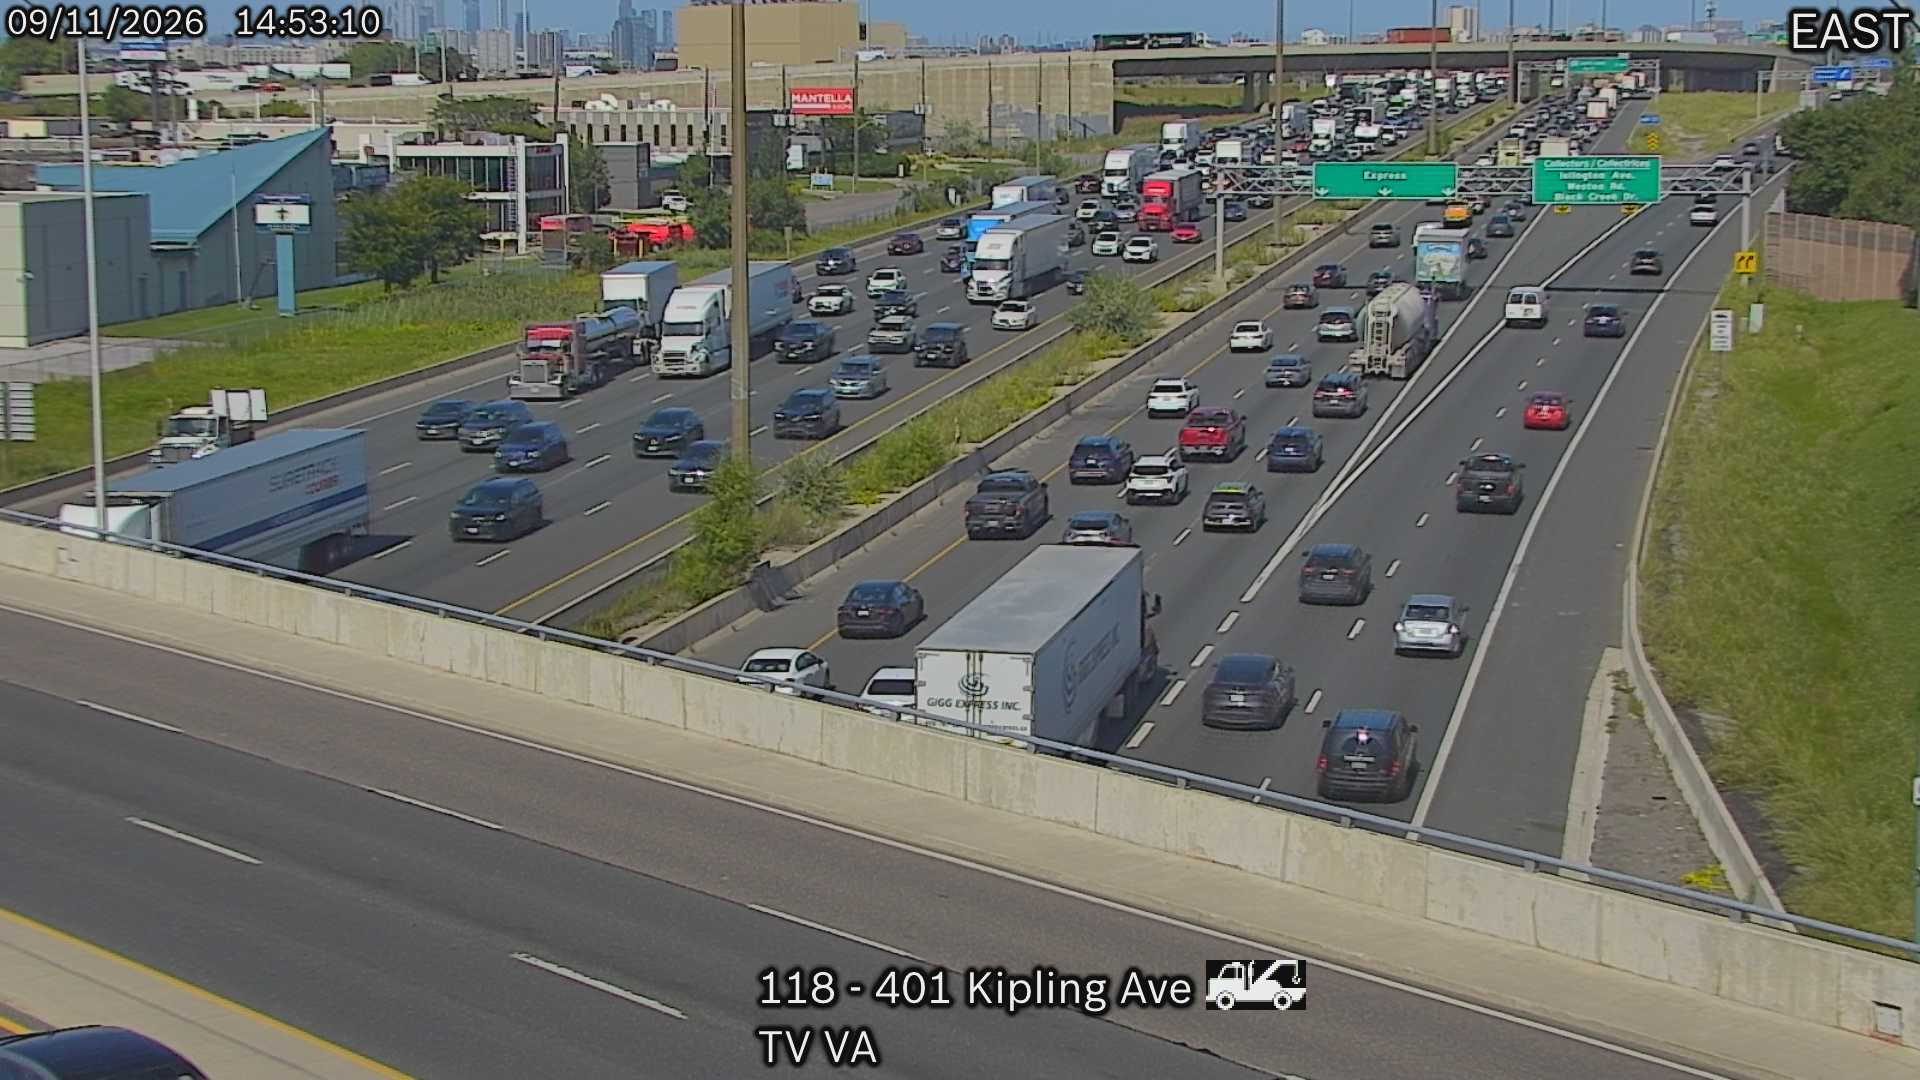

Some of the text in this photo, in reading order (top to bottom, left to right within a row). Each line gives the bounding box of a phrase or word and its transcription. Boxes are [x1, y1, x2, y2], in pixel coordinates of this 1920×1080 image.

[791, 93, 852, 103] MANTELLA
[1363, 171, 1407, 181] Express
[1560, 171, 1605, 181] Islington
